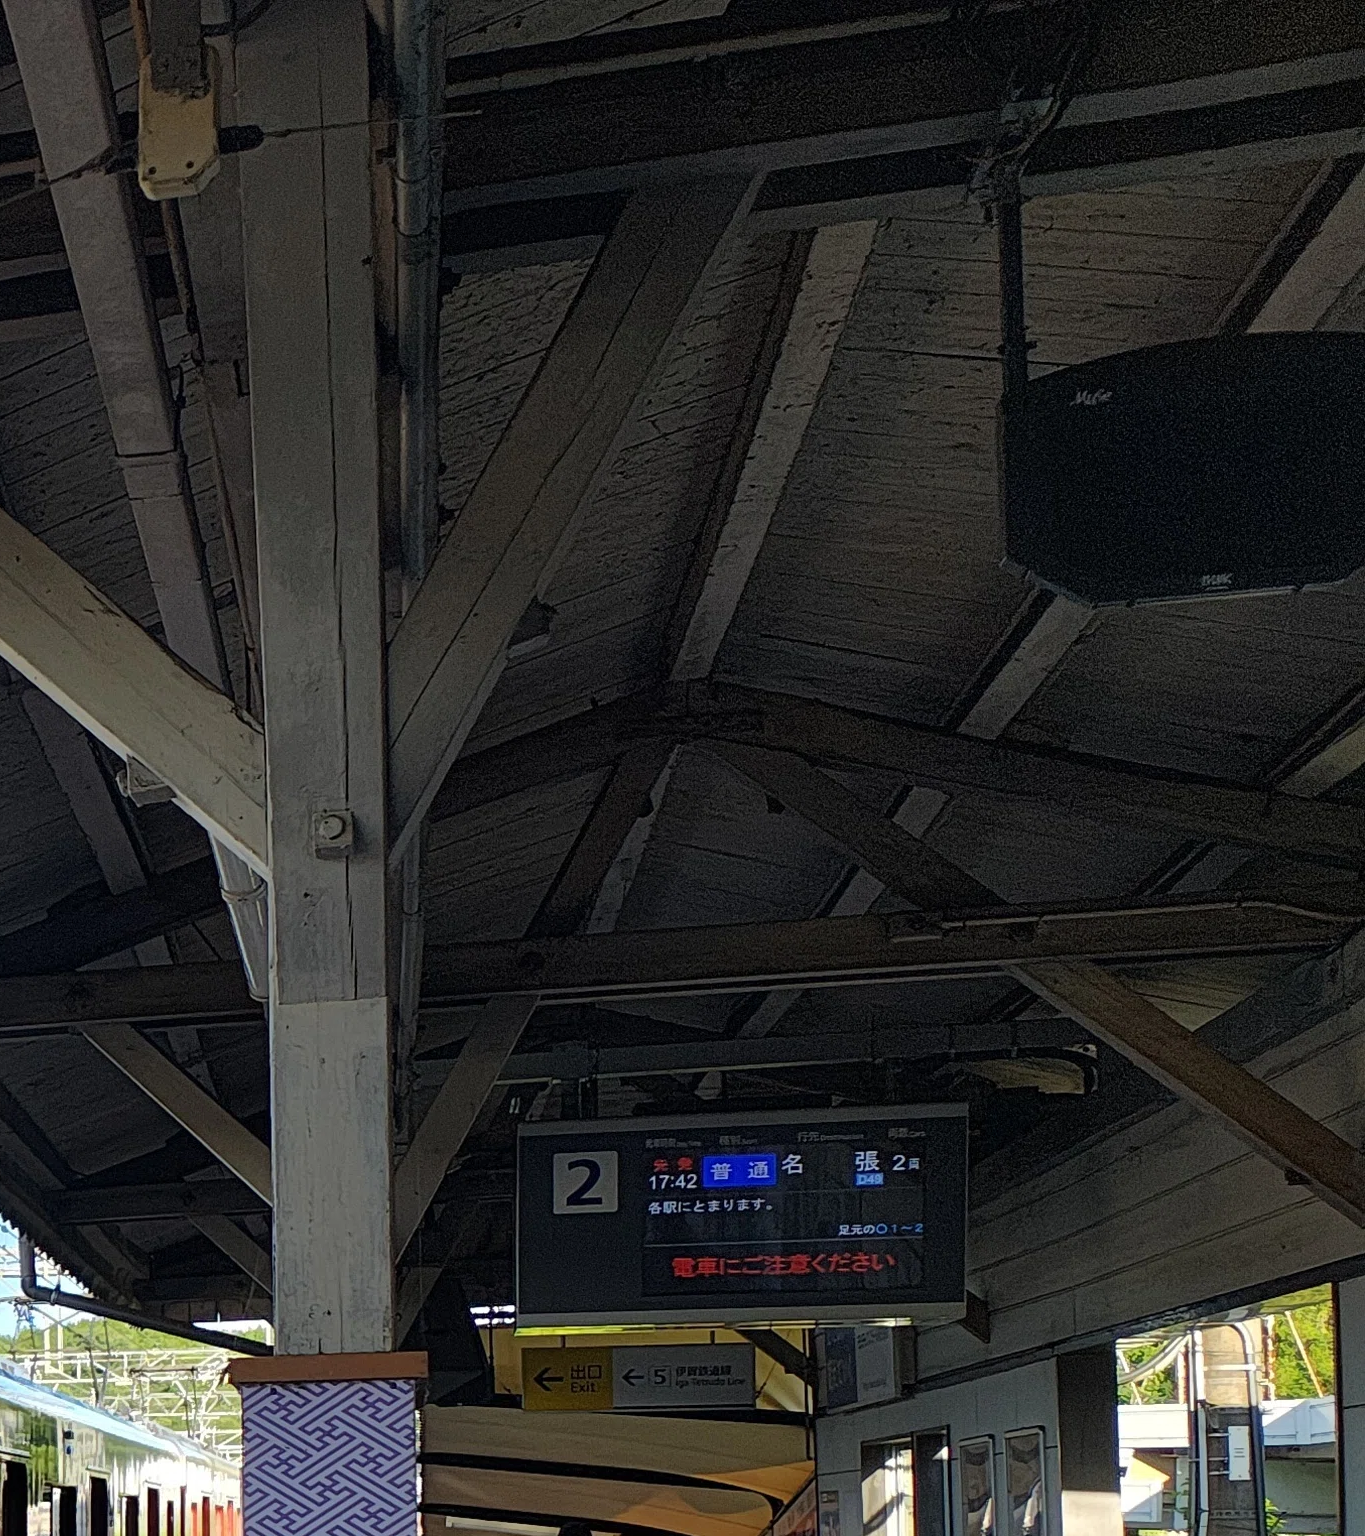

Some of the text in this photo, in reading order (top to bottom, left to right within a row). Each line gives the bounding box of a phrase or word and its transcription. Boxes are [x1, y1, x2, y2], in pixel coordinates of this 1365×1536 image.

[710, 1161, 770, 1181] 普通
[565, 1159, 603, 1207] 2
[648, 1174, 698, 1190] 17:42
[648, 1199, 773, 1215] 各駅にとまります。
[672, 1253, 897, 1278] 電車にご注意ください
[571, 1364, 602, 1380] 出口
[653, 1368, 666, 1385] 5
[571, 1381, 597, 1393] Exit
